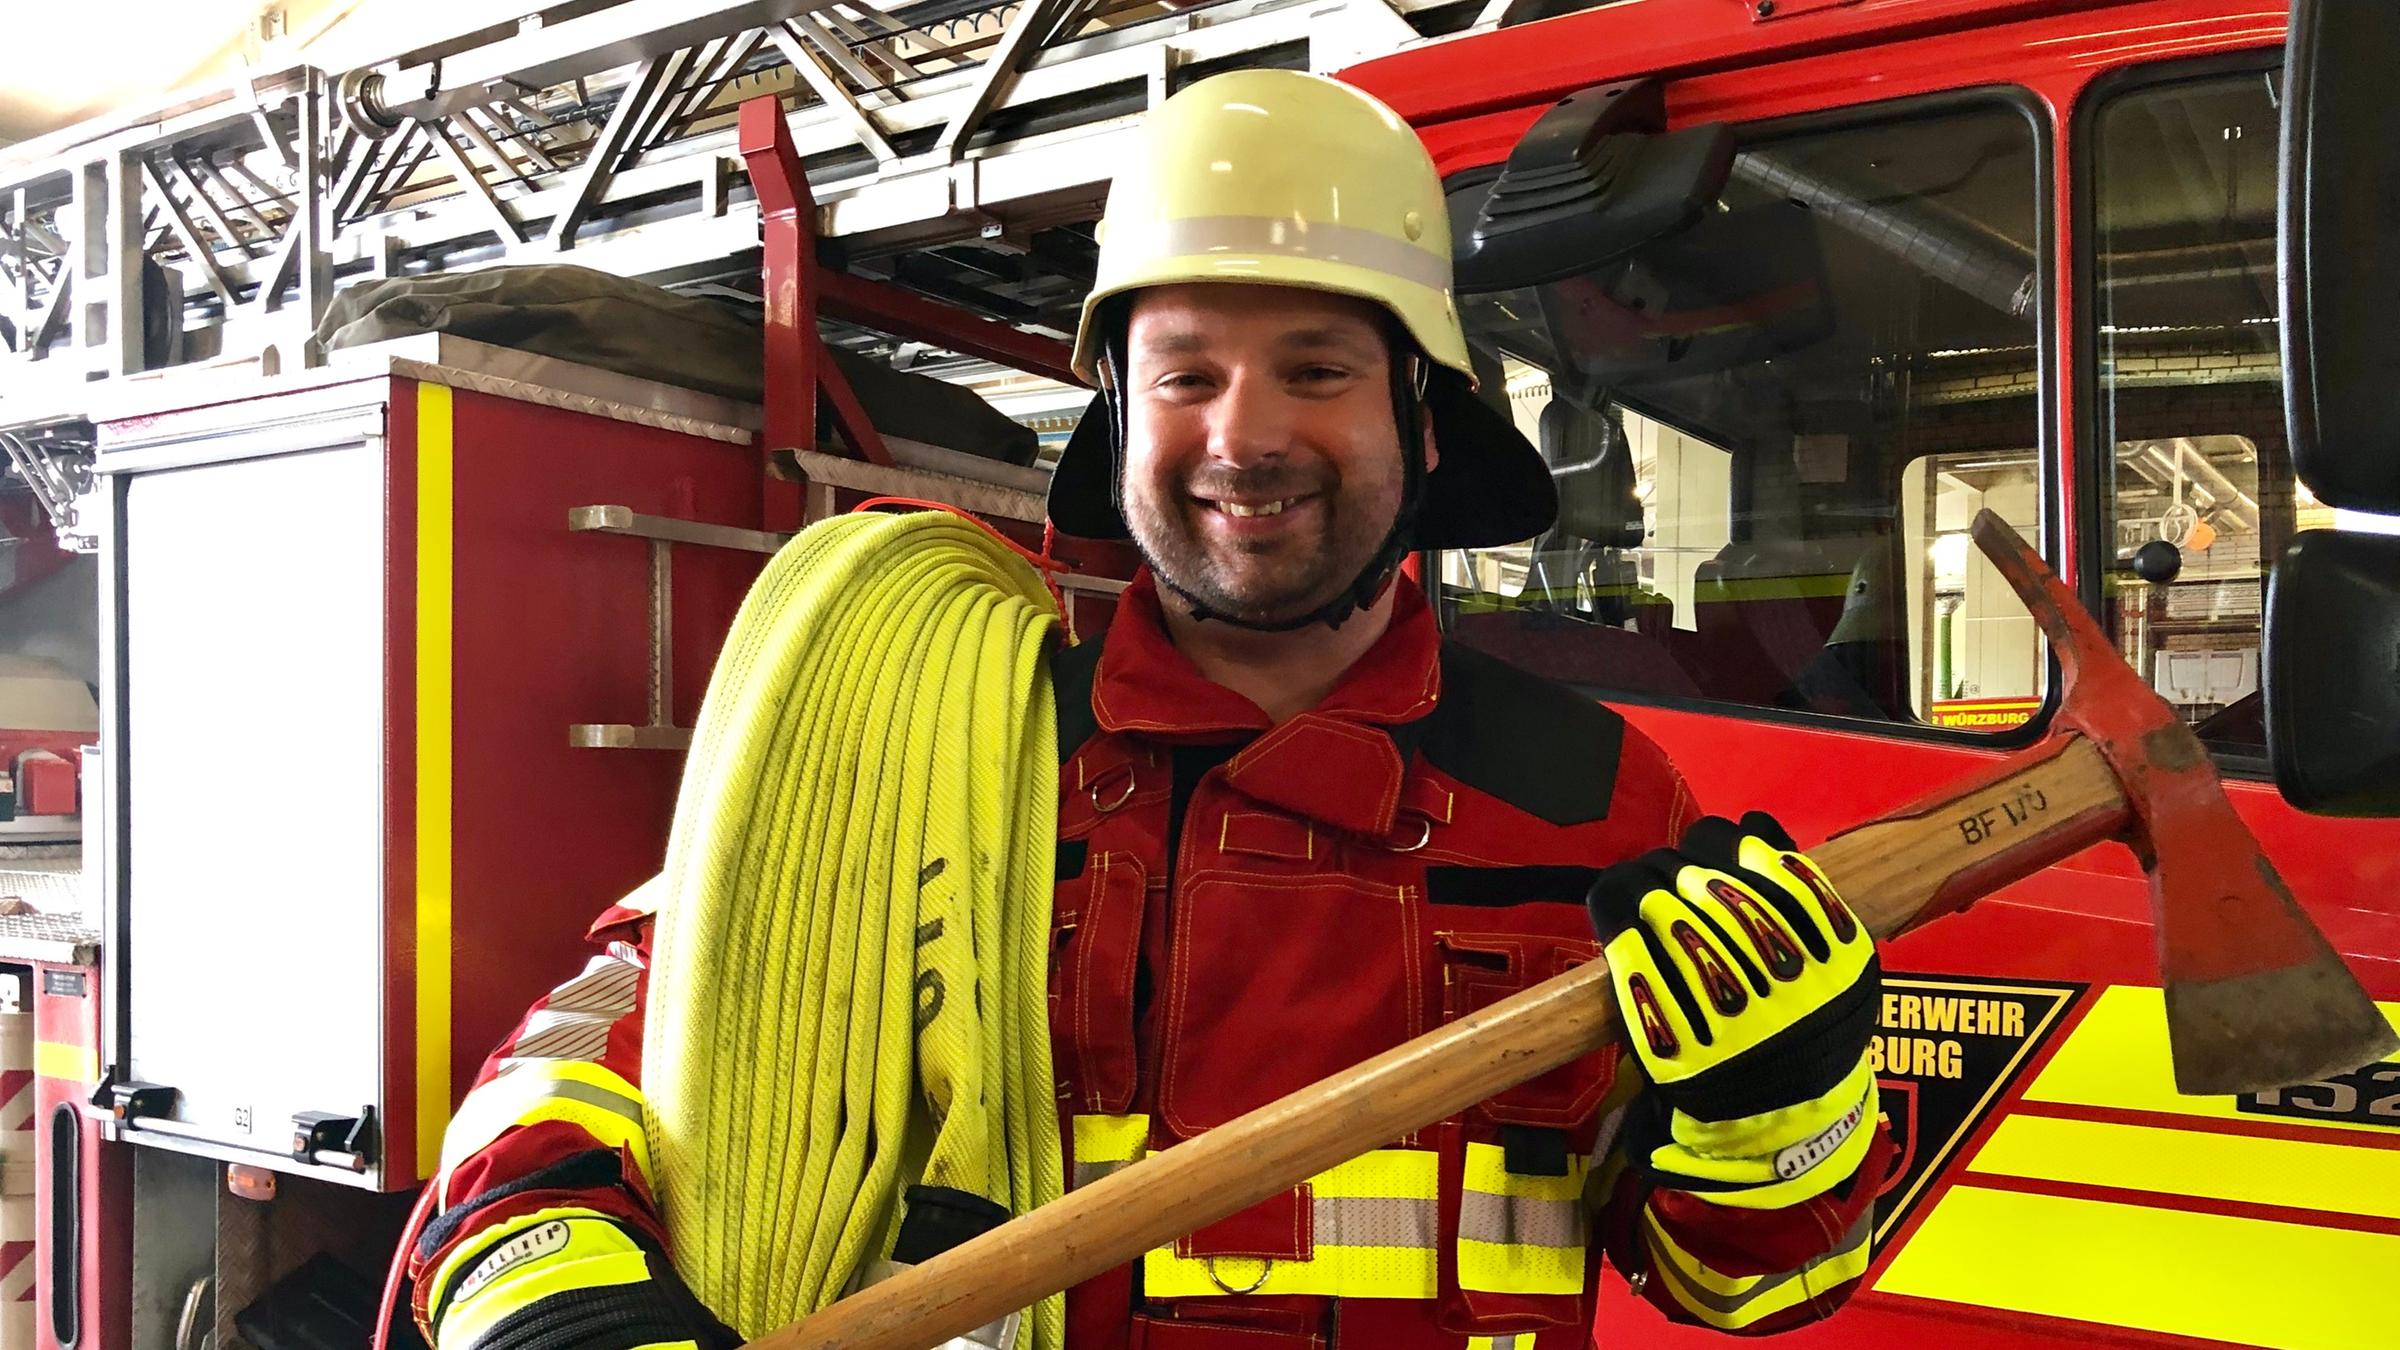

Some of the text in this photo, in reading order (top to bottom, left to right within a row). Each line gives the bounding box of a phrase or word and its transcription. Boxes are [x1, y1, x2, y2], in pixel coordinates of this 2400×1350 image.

[1943, 712, 2030, 726] WÜRZBURG
[1959, 807, 1996, 845] BF
[1876, 994, 2025, 1037] ERWEHR
[1869, 1035, 1963, 1079] BURG
[235, 1107, 249, 1128] G2
